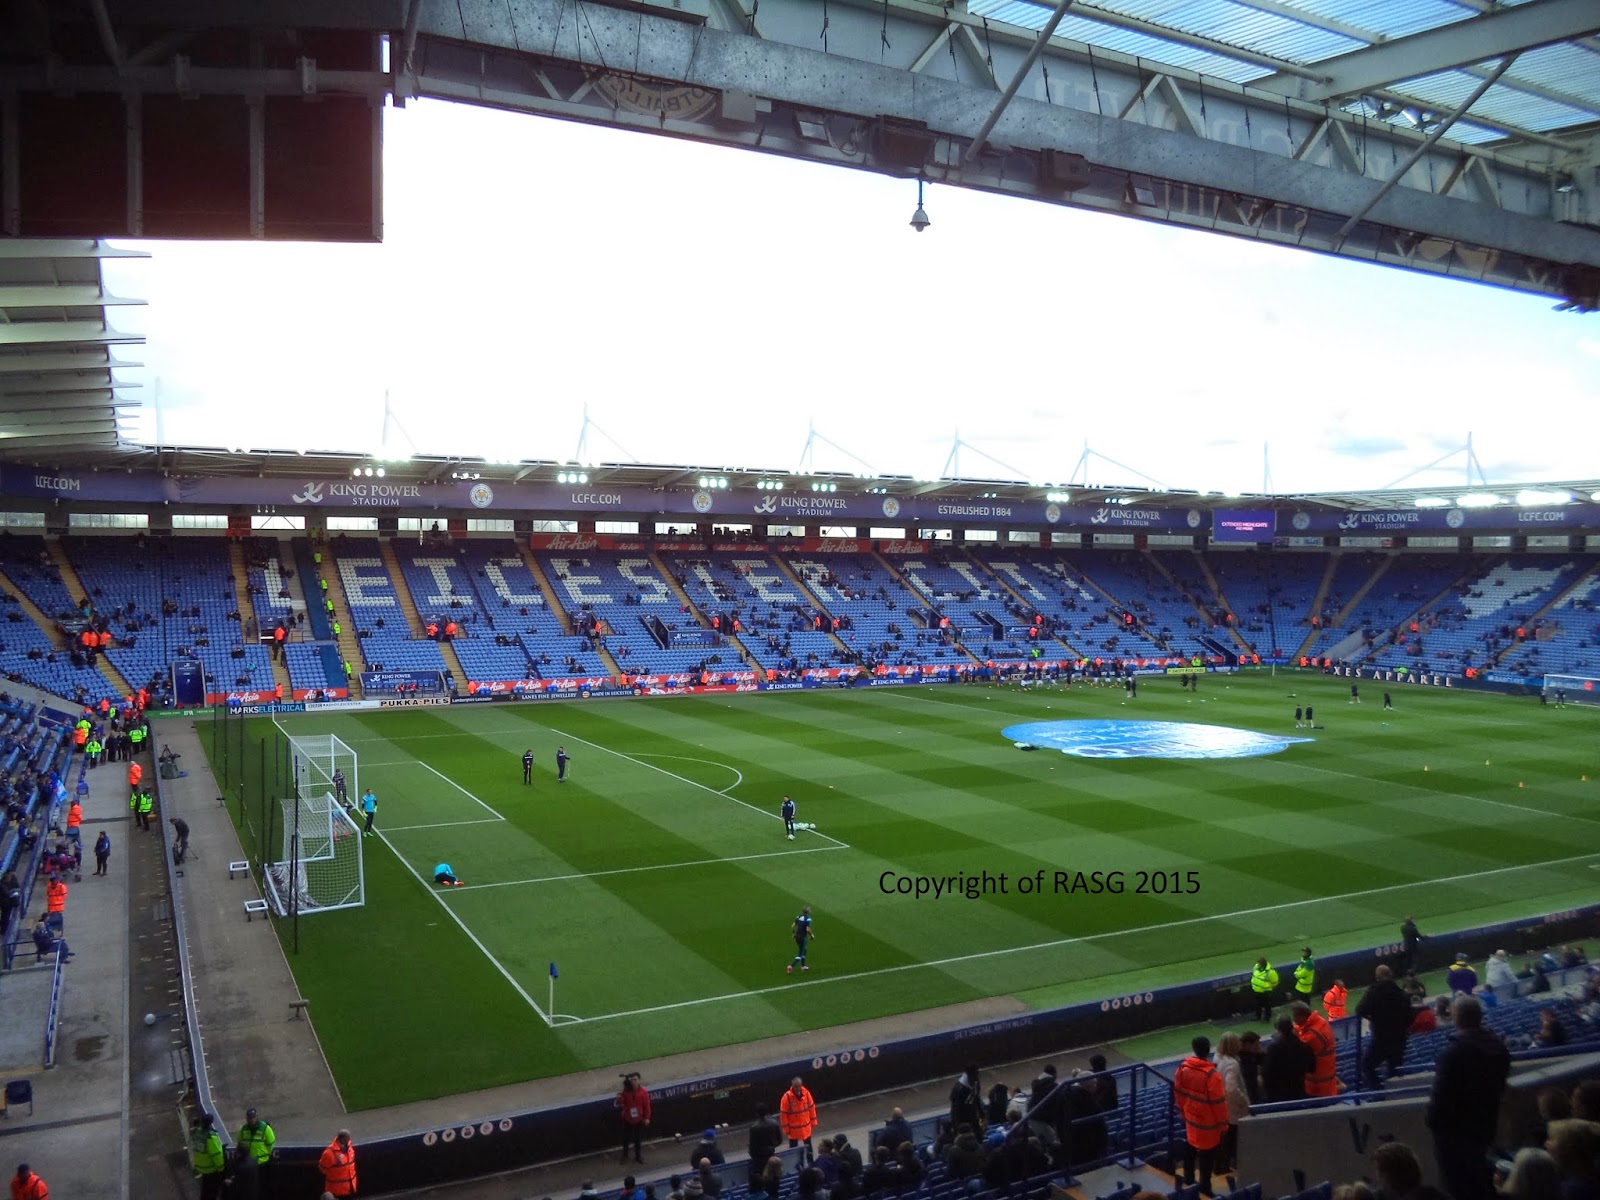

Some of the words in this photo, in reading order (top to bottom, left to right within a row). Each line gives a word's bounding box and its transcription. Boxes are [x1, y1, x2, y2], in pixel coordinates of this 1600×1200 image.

[35, 475, 80, 491] LCFC.COM
[329, 483, 368, 497] KING
[370, 484, 421, 498] POWER
[352, 498, 400, 506] STADIUM
[571, 493, 621, 505] LCFC.COM
[780, 497, 808, 509] KING
[810, 497, 847, 509] POWER
[797, 508, 831, 516] STADIUM
[937, 505, 989, 516] ESTABLISHED
[991, 507, 1011, 517] 1884
[1111, 509, 1132, 519] KING
[1133, 509, 1160, 520] POWER
[1518, 511, 1564, 521] LCFC.COM
[1361, 513, 1386, 523] KING
[1386, 513, 1419, 523] POWER
[262, 557, 852, 607] LEICESTER
[1373, 671, 1452, 687] APPAREL
[665, 1086, 688, 1098] WITH
[689, 1080, 717, 1092] #LCFC
